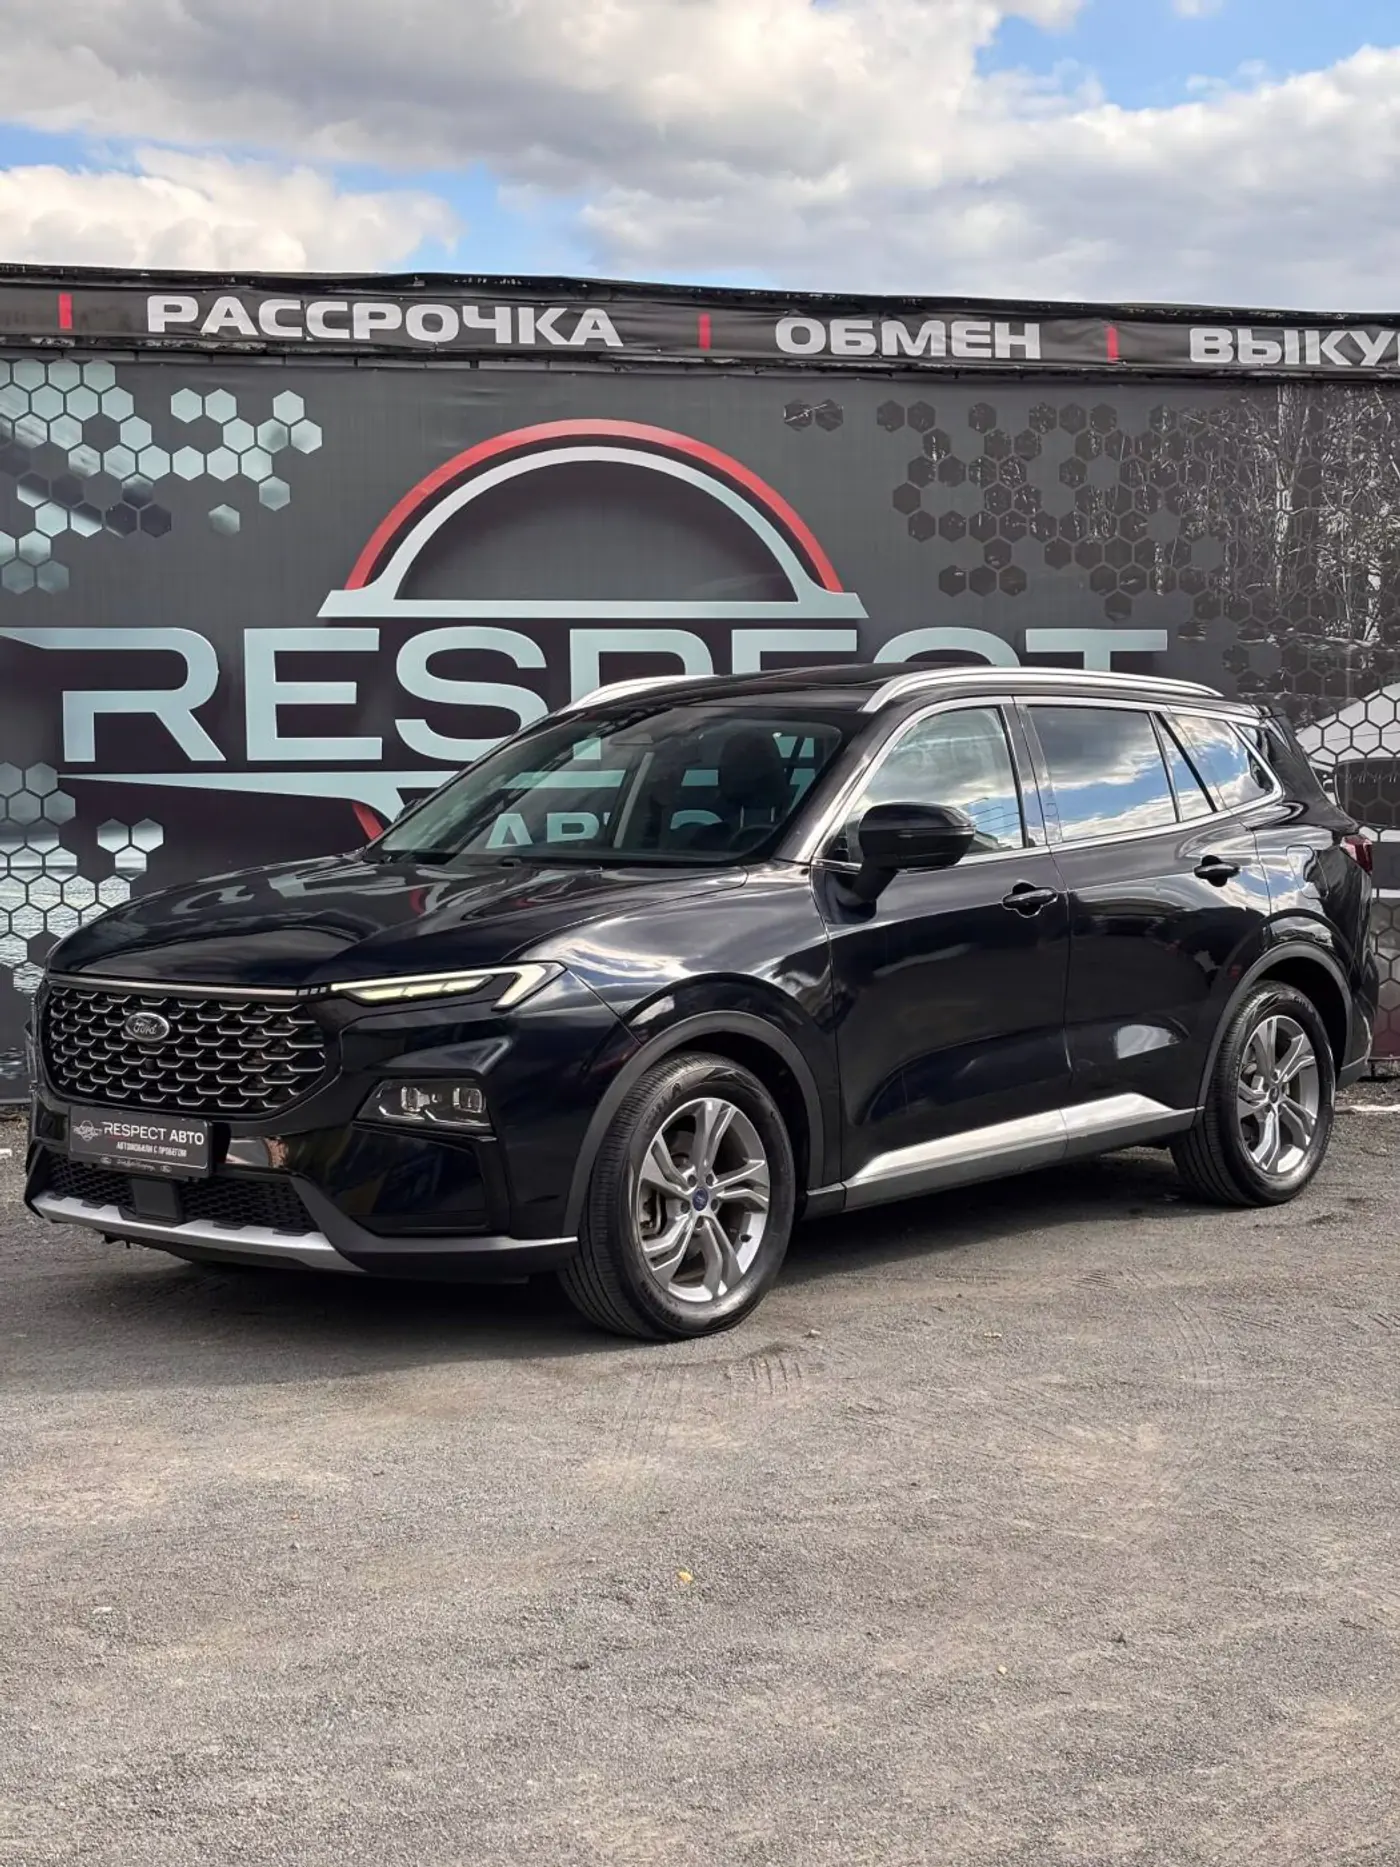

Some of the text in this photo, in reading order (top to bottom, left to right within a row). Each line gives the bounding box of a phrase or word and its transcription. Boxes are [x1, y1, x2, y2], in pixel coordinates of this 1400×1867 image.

[147, 295, 1400, 367] РАССРОЧКА ОБМЕН ВЫКУ
[101, 1121, 167, 1141] RESPECT
